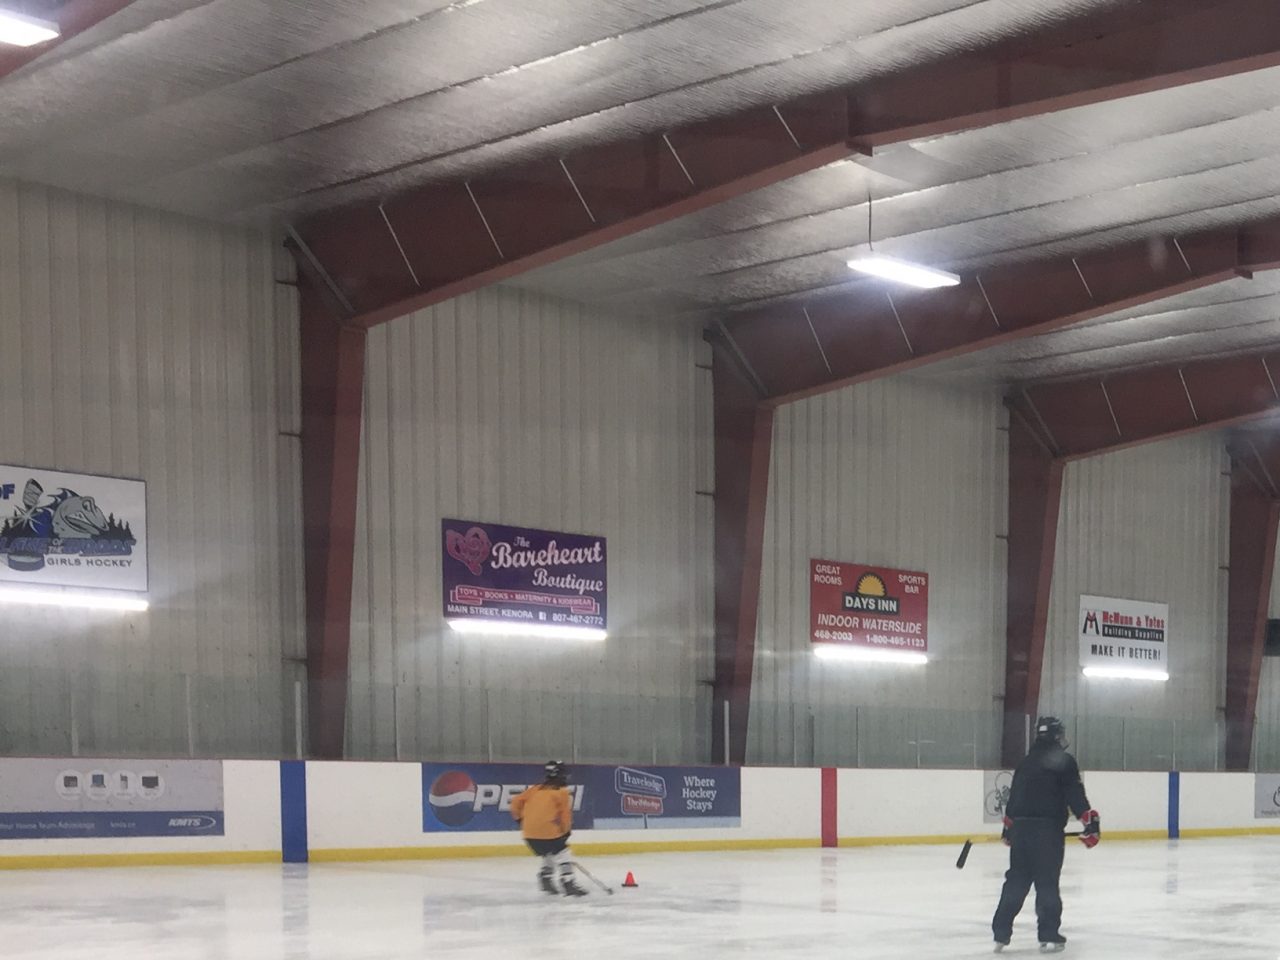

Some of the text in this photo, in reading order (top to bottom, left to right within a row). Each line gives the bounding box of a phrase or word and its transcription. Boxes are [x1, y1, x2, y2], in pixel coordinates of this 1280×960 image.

[0, 483, 15, 500] F
[513, 535, 530, 548] The
[46, 557, 133, 568] GIRLS HOCKEY
[490, 540, 604, 569] Bareheart
[532, 567, 604, 595] Boutique
[815, 563, 927, 586] GREAT SPORTS
[813, 574, 920, 594] ROOMS BAR
[459, 587, 479, 597] TOYS
[484, 590, 510, 600] BOOKS
[515, 594, 551, 604] MATERNITY
[844, 595, 898, 612] DAYS INN
[447, 604, 468, 614] MAIN
[501, 609, 534, 619] KENORA
[817, 613, 922, 634] INDOOR WATERSLIDE
[1136, 616, 1142, 627] &
[1091, 644, 1161, 661] MAKE IT BETTER!
[621, 771, 664, 792] Travelodge
[683, 775, 716, 788] Where
[473, 784, 585, 812] PEI
[682, 788, 717, 801] Hockey
[686, 799, 713, 813] Stays
[168, 818, 201, 828] KMTS
